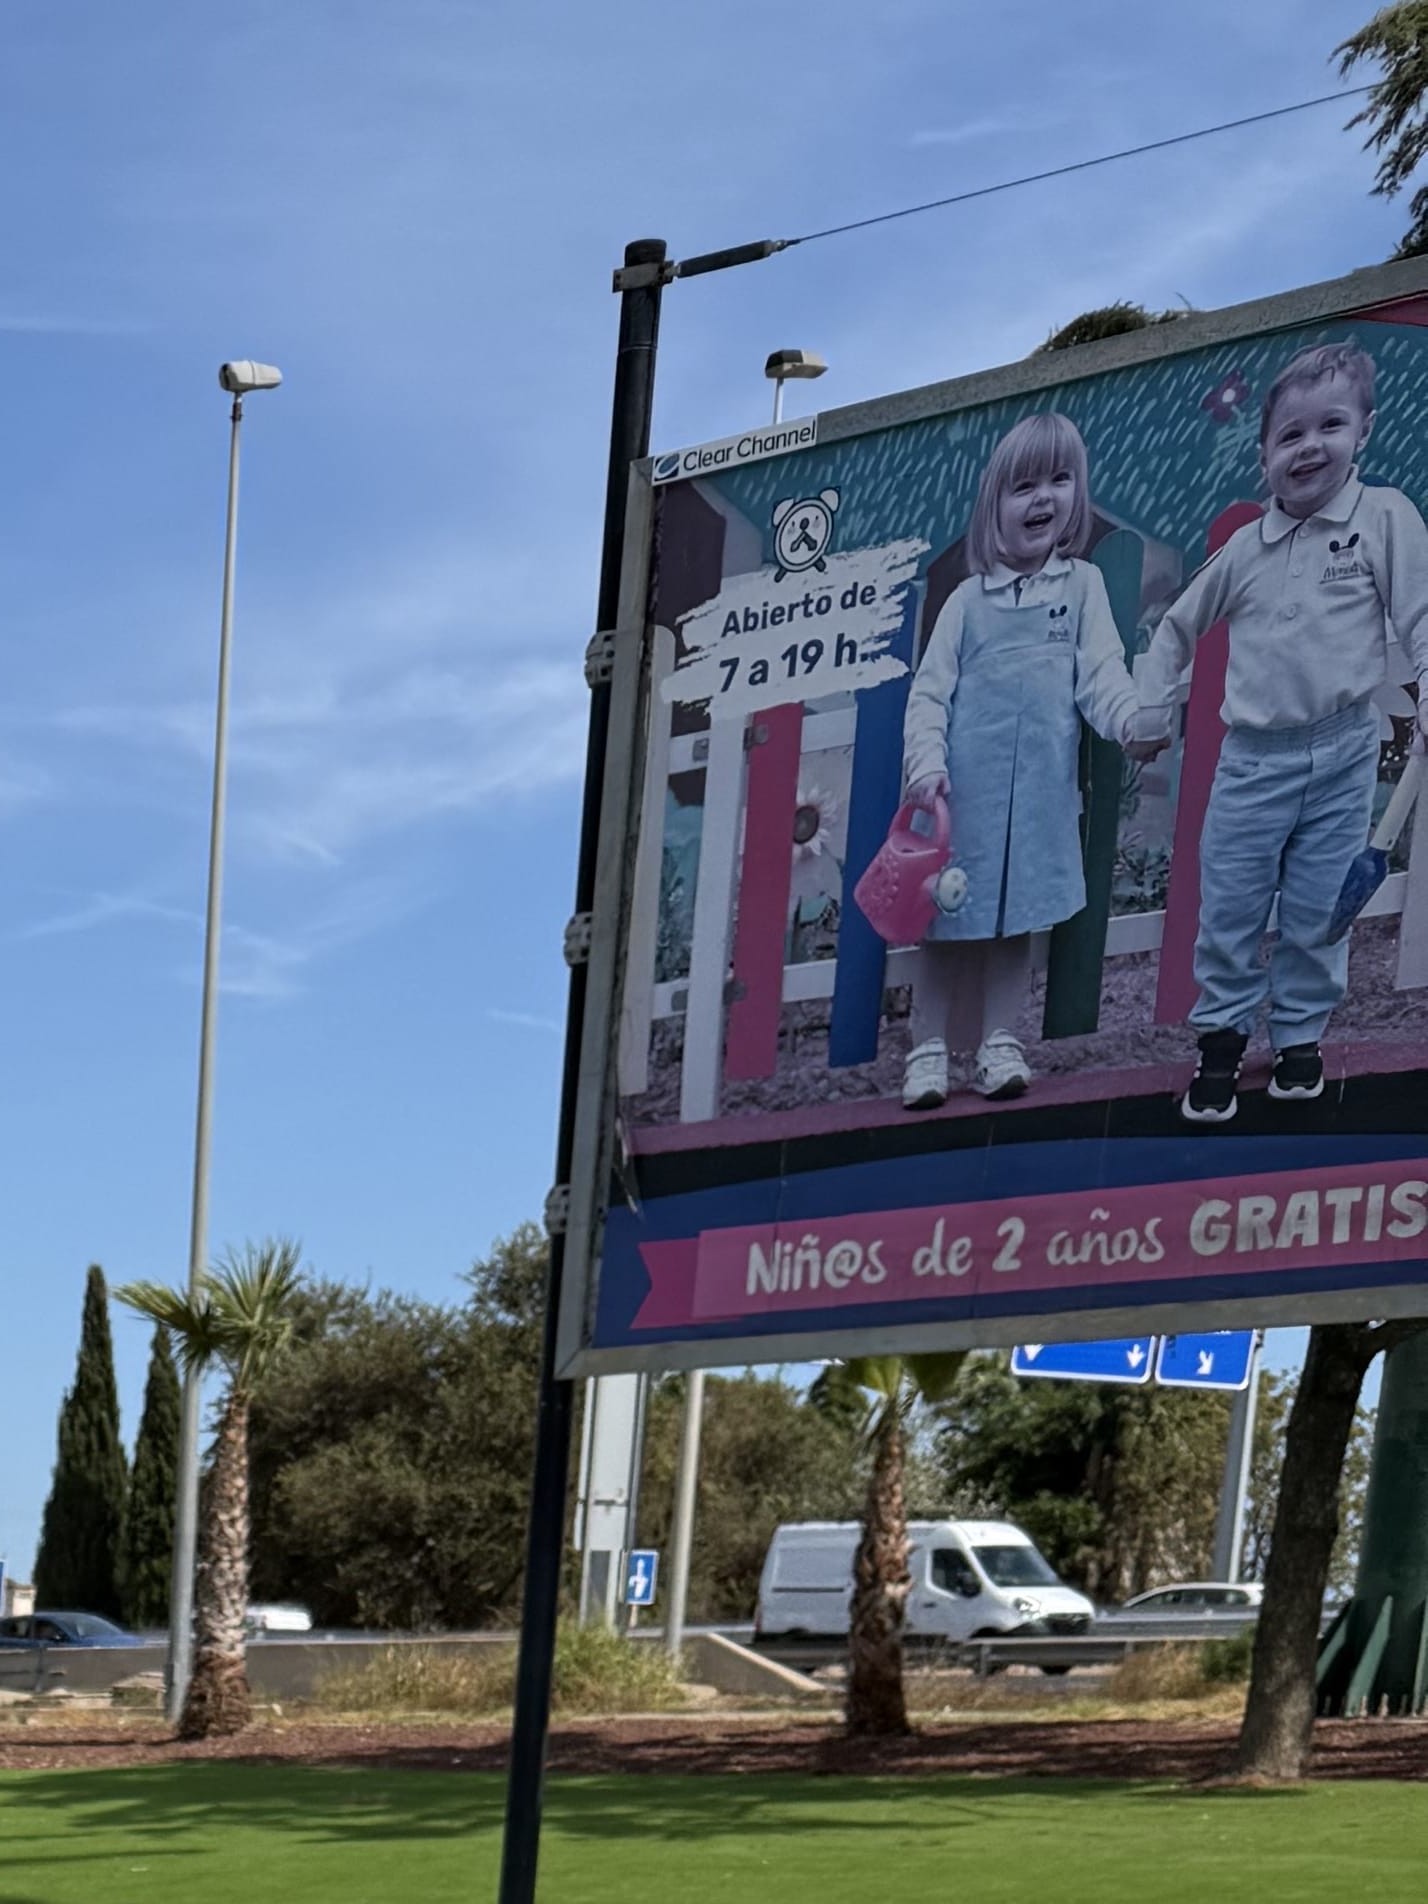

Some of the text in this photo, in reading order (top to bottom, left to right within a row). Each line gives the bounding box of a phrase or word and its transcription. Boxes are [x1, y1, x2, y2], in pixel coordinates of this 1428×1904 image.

[683, 420, 816, 471] Clear Channel
[721, 582, 876, 638] Abierto de
[719, 632, 870, 693] 7 a 19 h.
[746, 1180, 1428, 1295] Niñ@s de 2 años GRATIS
